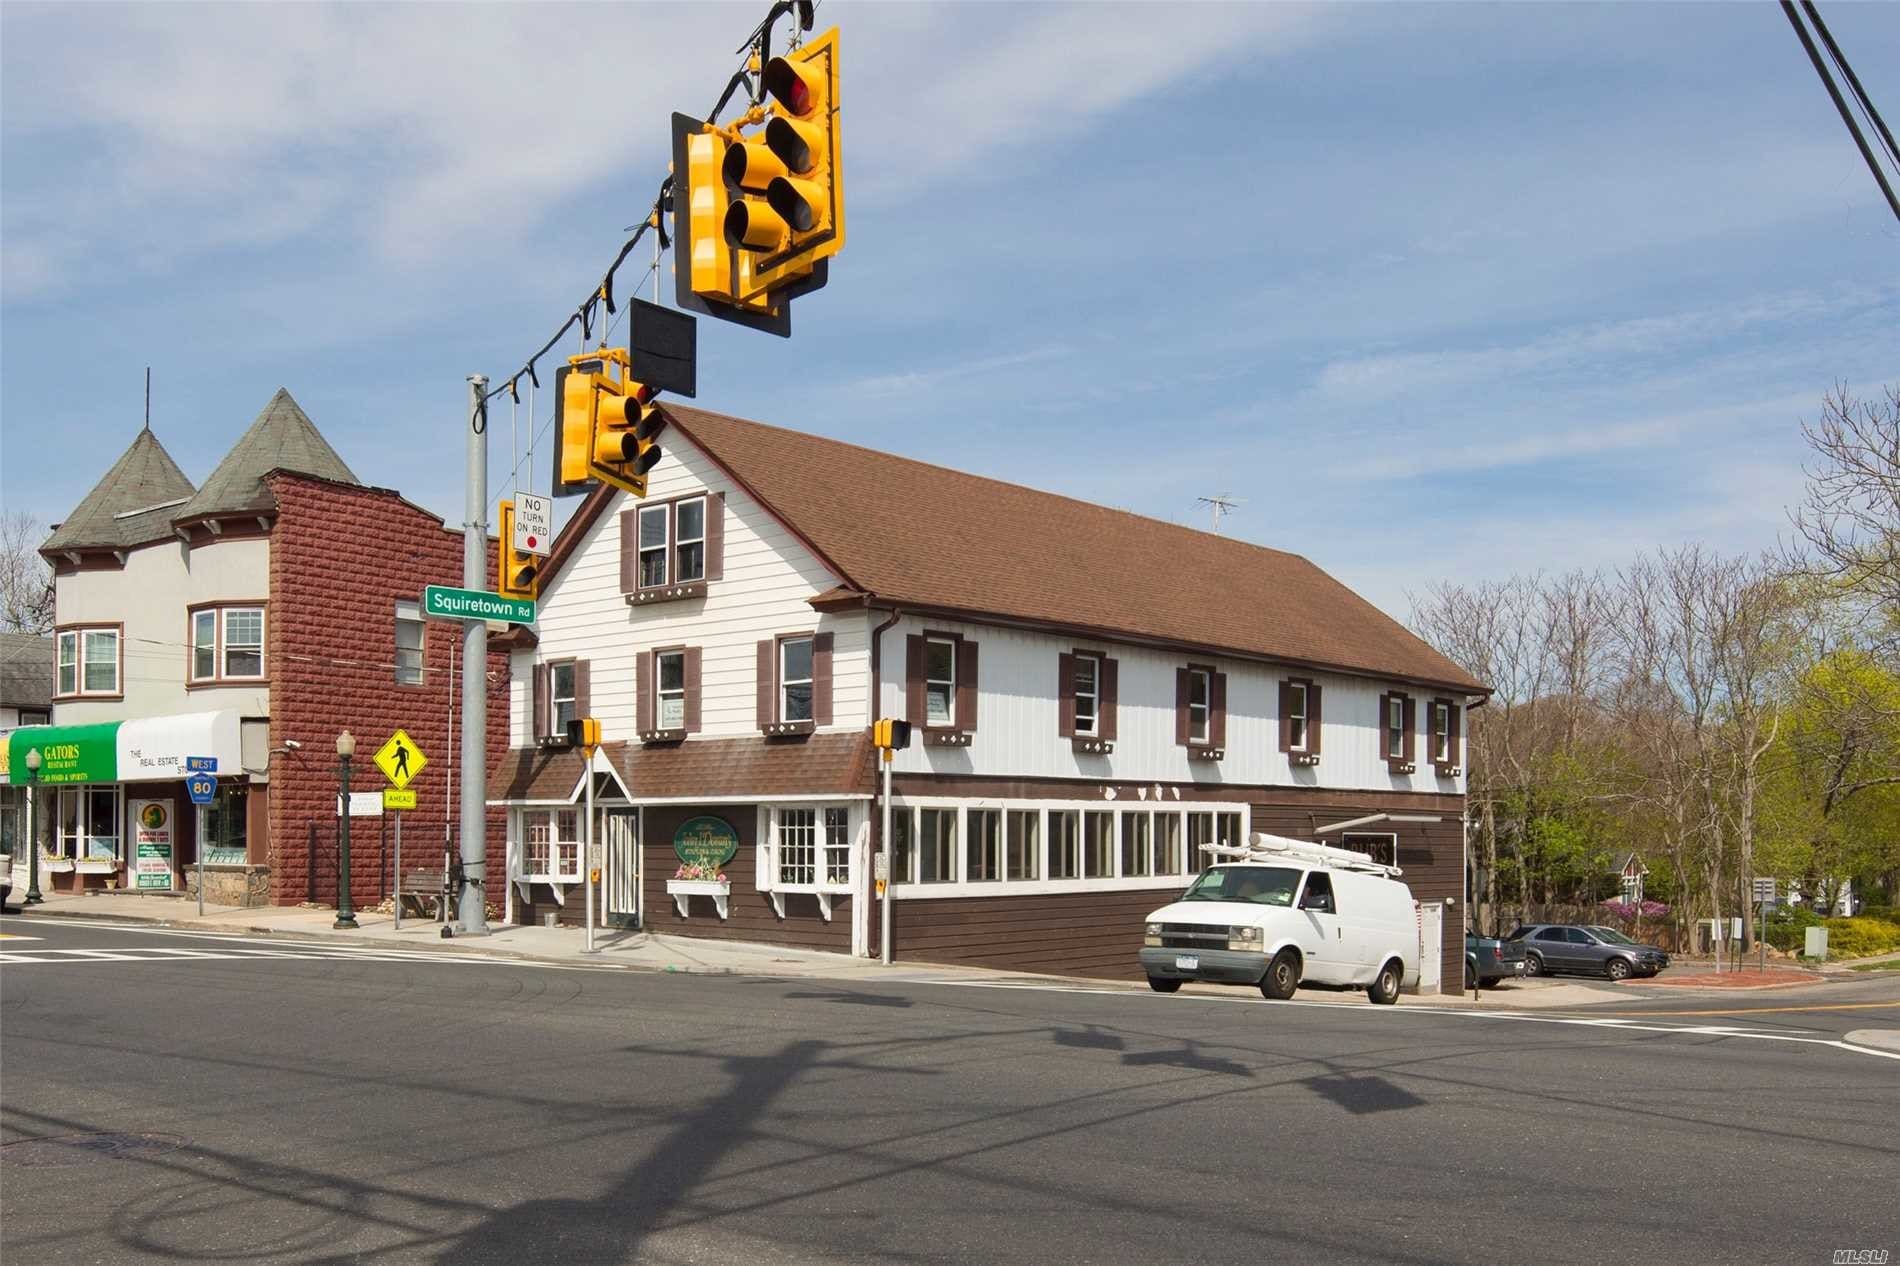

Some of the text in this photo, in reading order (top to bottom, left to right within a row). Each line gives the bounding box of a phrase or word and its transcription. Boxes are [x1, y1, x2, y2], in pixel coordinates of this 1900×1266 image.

[525, 498, 541, 511] NO
[523, 512, 544, 524] TURN
[517, 522, 548, 536] ON RED
[434, 593, 531, 617] Squiretown Rd
[44, 744, 80, 760] GATORS
[130, 749, 141, 758] THE
[140, 757, 179, 767] REAL ESTATE
[191, 759, 213, 769] WEST
[194, 782, 211, 794] 80
